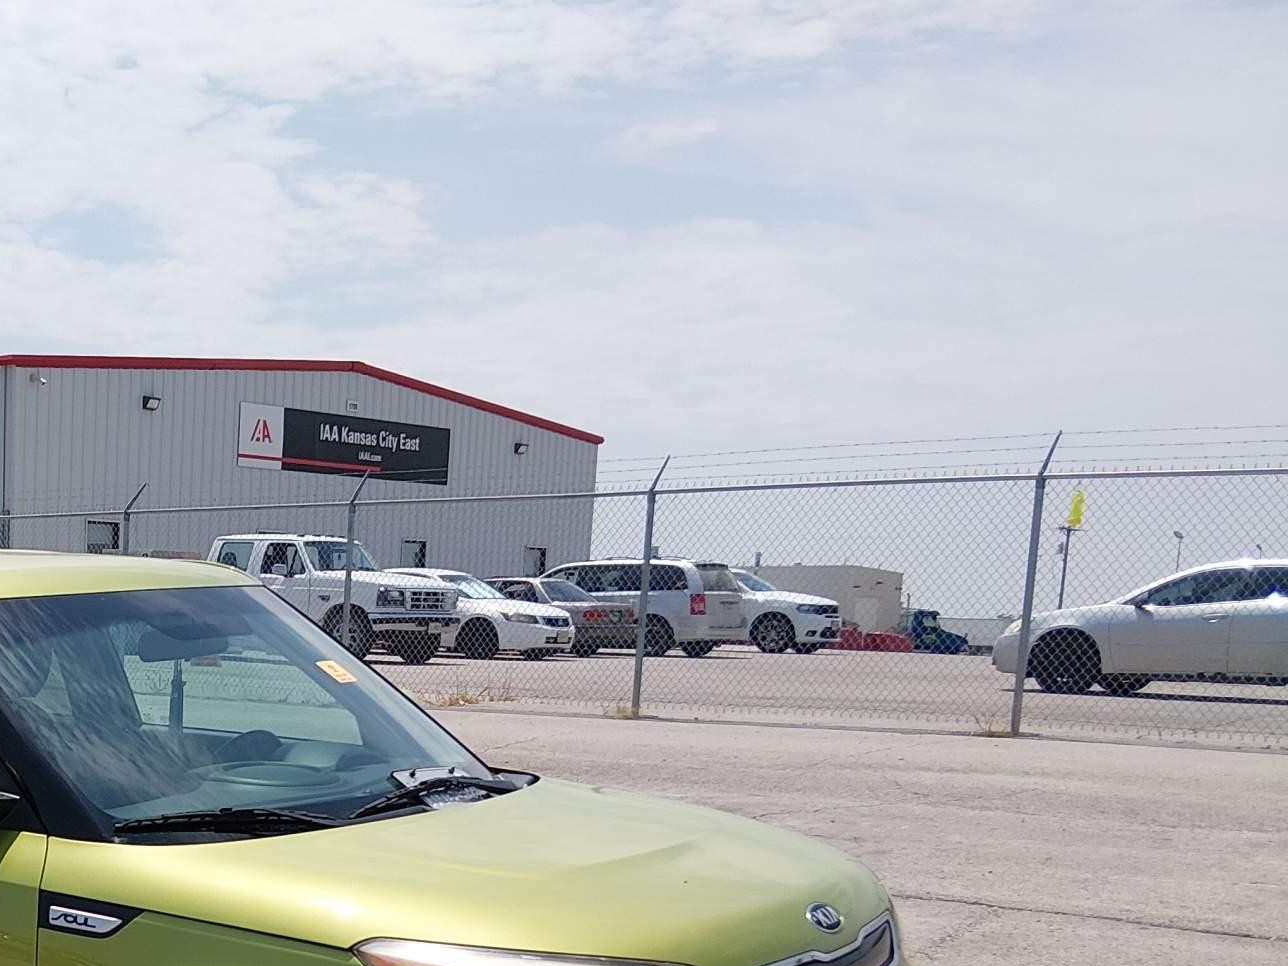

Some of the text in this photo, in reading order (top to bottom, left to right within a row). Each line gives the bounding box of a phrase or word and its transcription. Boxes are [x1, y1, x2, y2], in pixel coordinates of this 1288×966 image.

[319, 423, 420, 453] IAA Kansas City East
